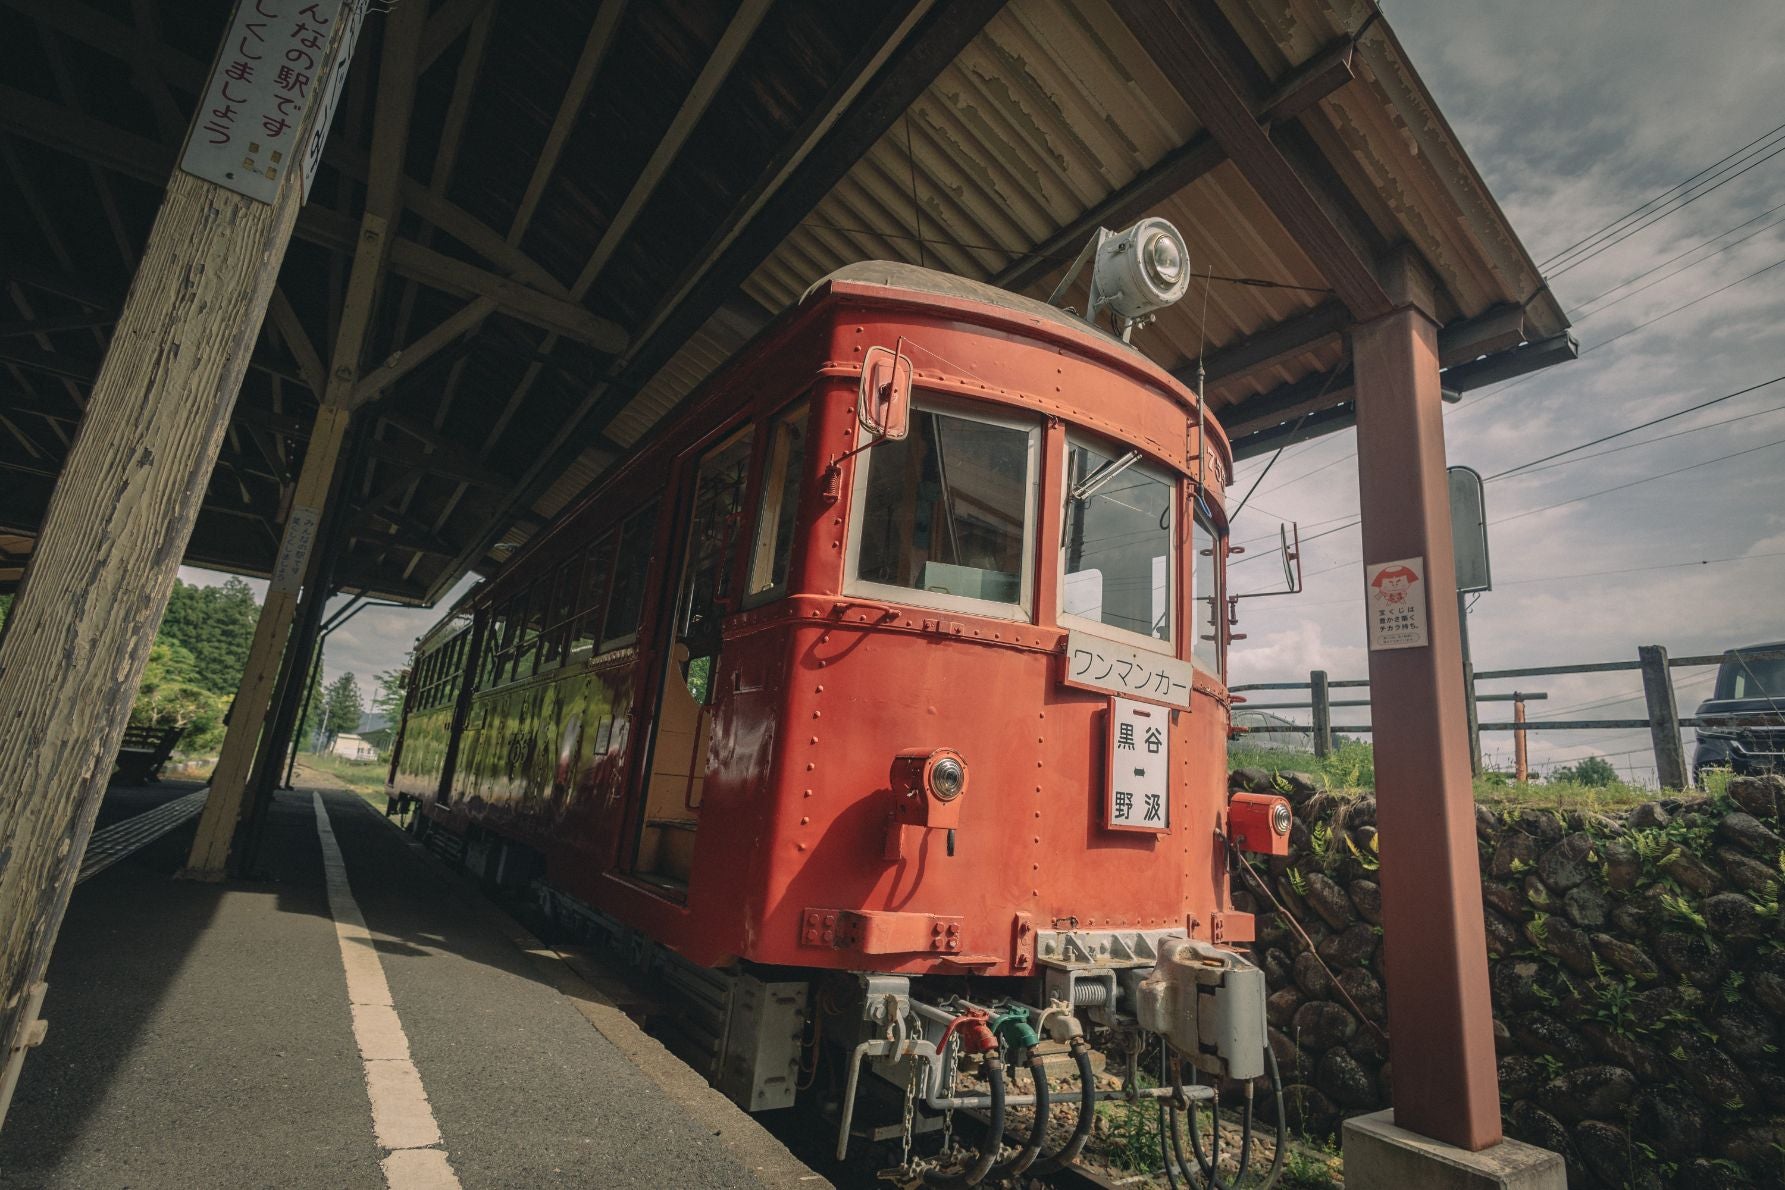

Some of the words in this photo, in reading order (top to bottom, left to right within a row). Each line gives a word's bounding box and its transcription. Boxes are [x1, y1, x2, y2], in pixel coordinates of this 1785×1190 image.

[1074, 649, 1187, 695] ワンマンカー
